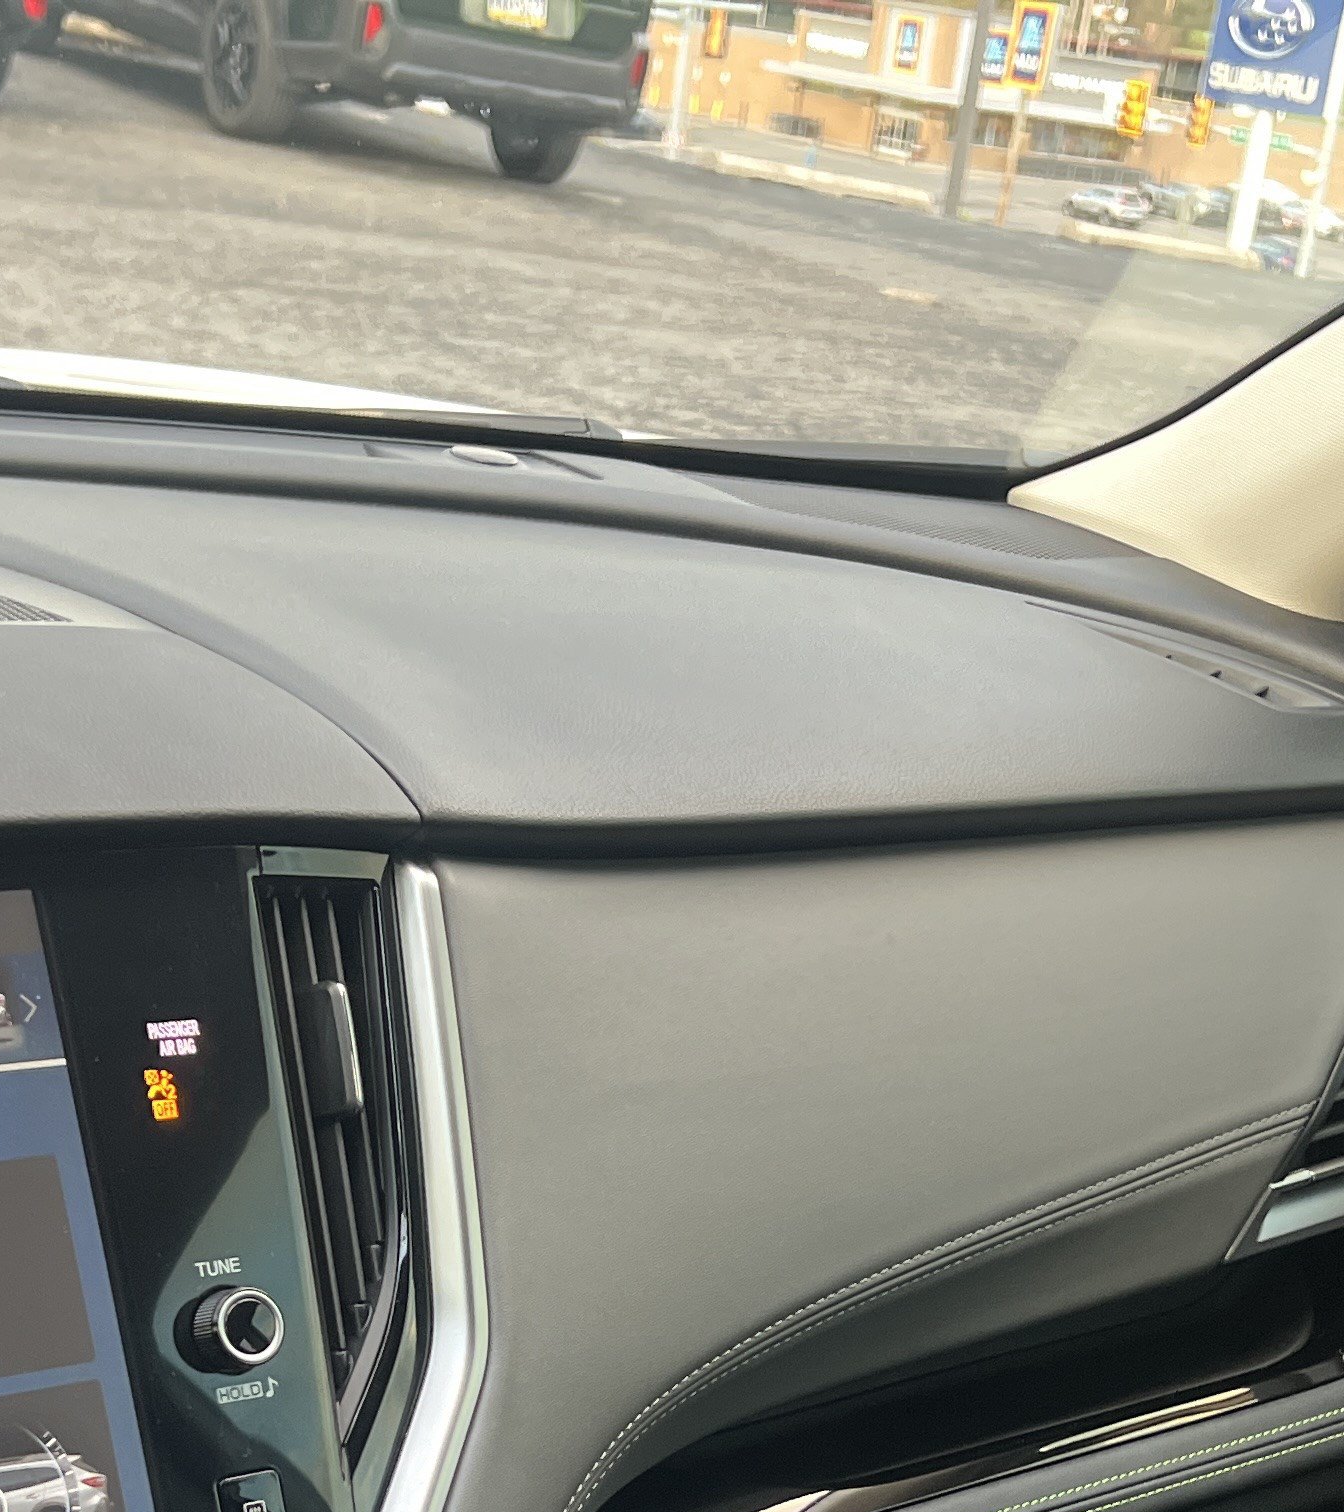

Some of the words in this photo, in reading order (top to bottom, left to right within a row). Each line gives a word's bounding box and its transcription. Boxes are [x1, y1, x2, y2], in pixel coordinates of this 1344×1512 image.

[1208, 61, 1320, 105] SUBARU
[146, 1018, 201, 1040] PASSENGER
[153, 1100, 178, 1119] OFF
[194, 1257, 242, 1278] TUNE
[217, 1382, 262, 1403] HOLD
